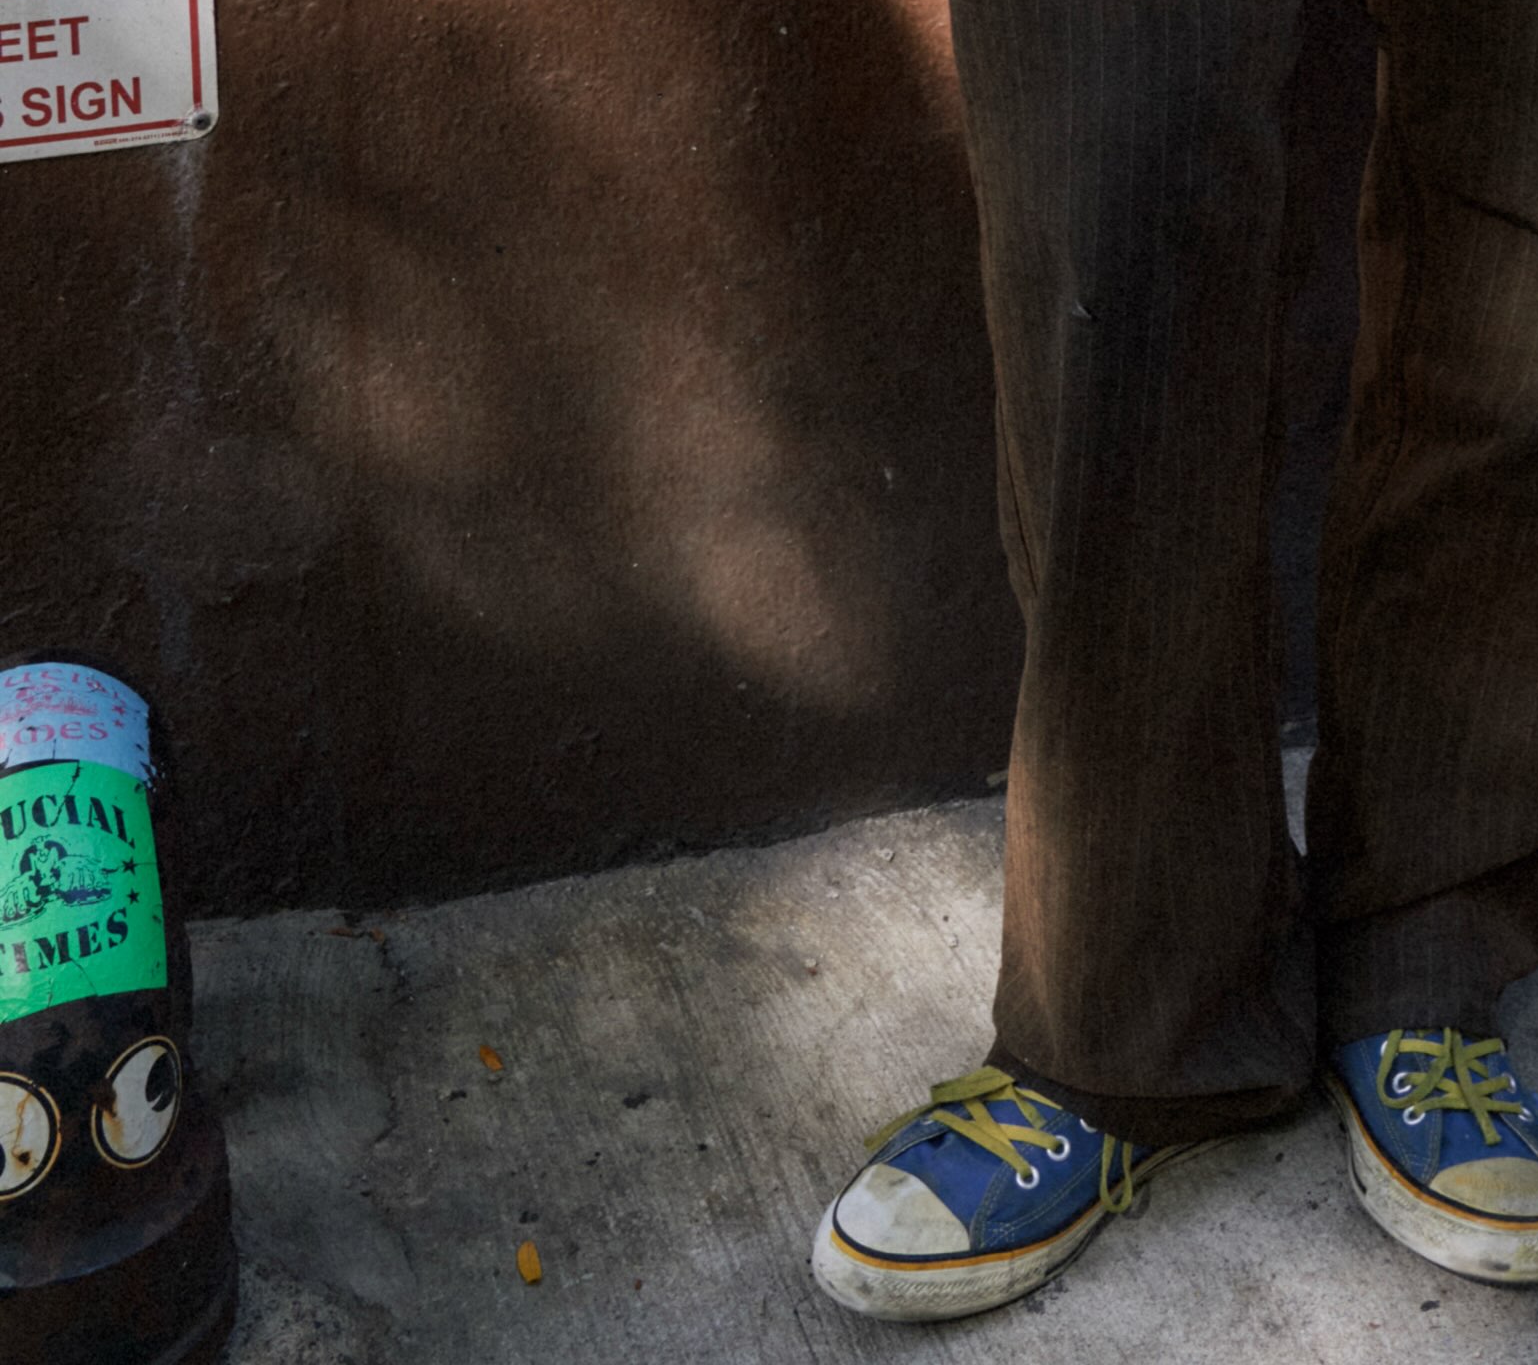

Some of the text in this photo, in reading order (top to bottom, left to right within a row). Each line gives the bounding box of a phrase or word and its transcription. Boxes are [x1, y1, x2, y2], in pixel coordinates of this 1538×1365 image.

[0, 16, 89, 64] EET
[21, 76, 142, 127] SIGN
[0, 794, 136, 850] UCIAL
